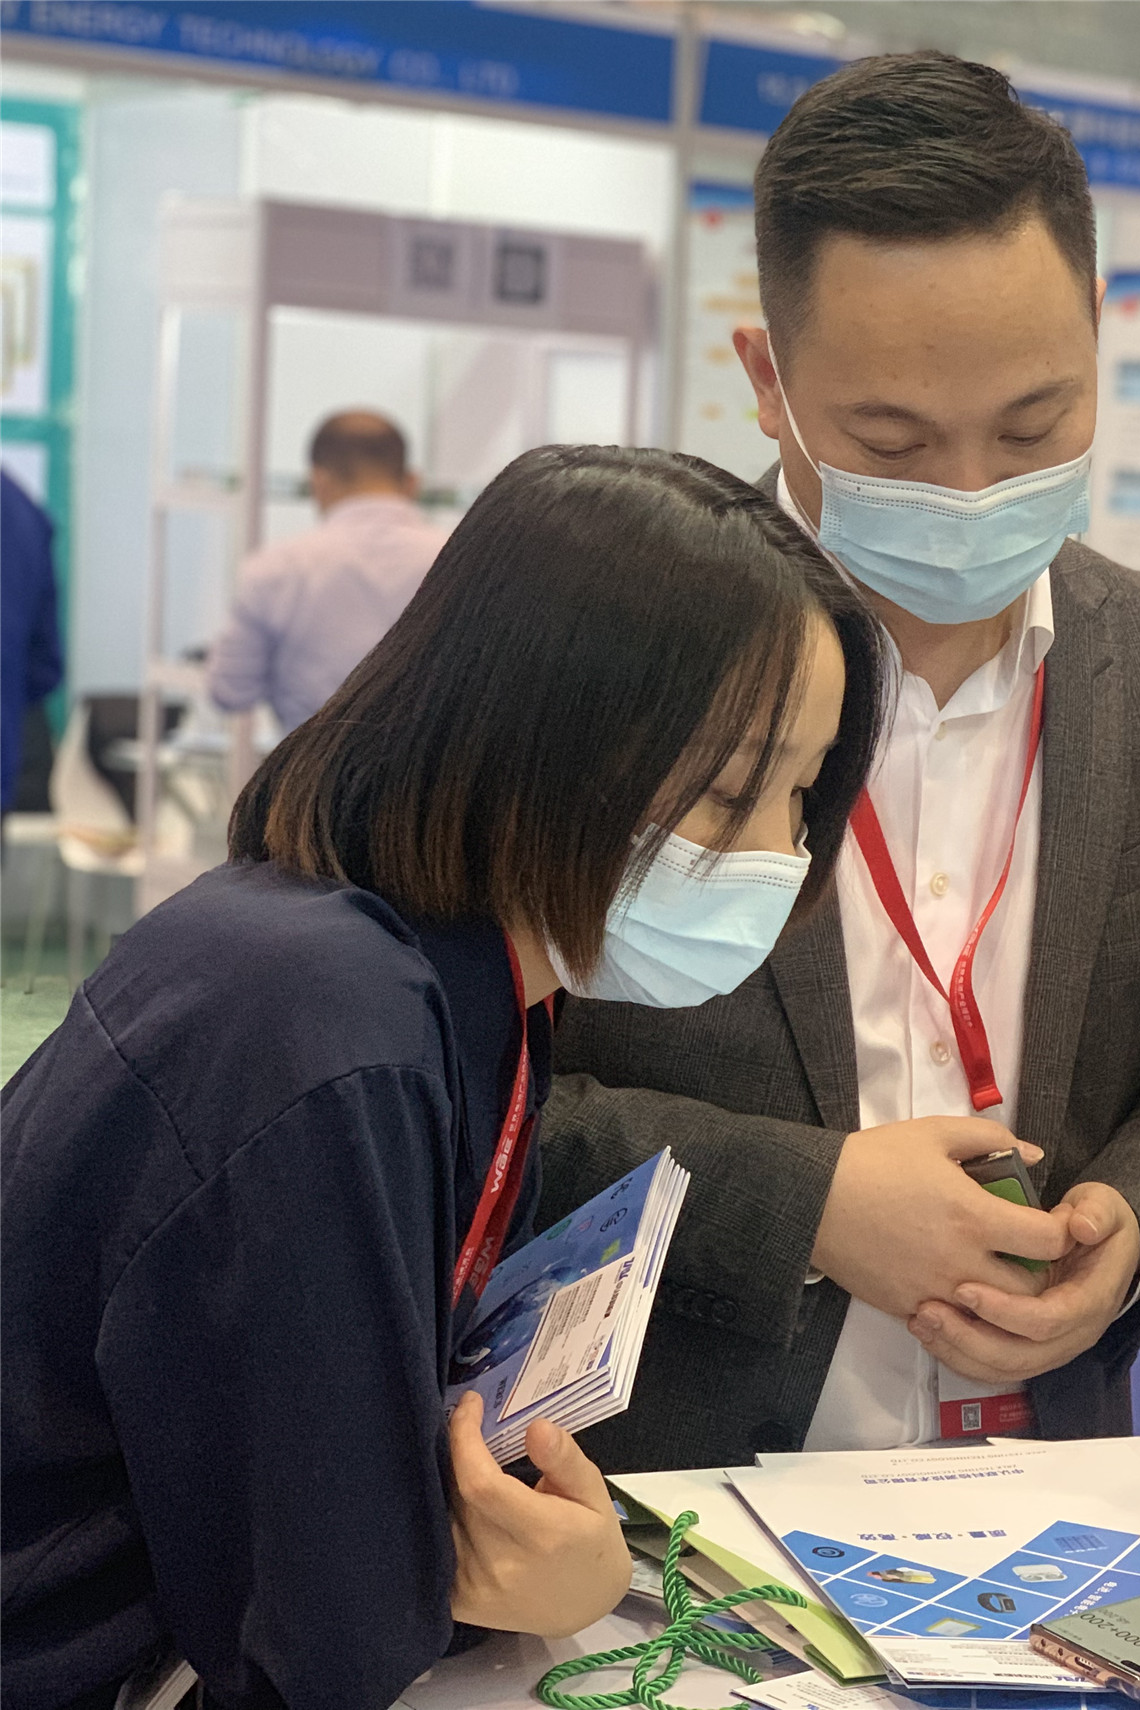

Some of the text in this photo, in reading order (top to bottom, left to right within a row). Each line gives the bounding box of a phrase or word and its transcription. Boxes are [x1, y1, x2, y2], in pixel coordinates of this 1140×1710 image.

[179, 13, 381, 76] TECHNOLOGY
[864, 1469, 1025, 1485] 中认联科检测技术有限公司
